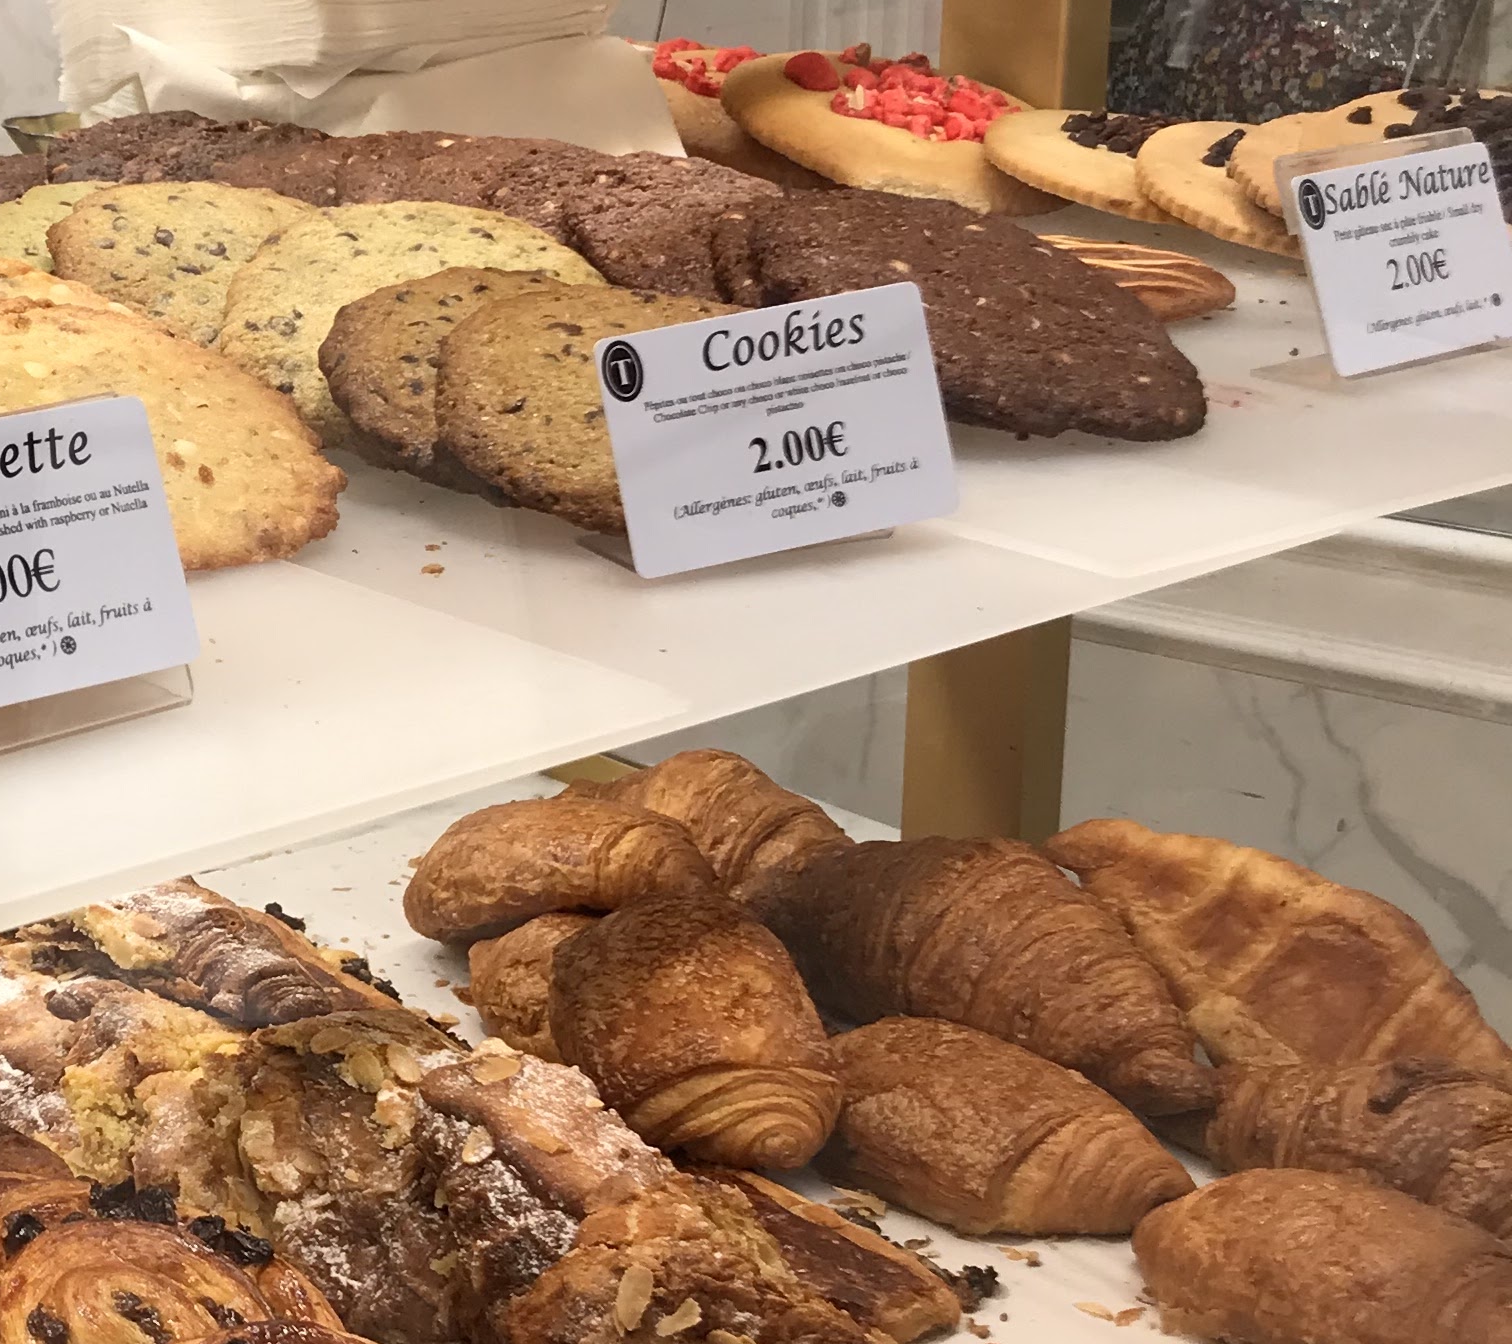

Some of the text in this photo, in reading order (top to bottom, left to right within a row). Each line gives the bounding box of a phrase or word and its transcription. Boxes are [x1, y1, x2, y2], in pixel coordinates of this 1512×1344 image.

[1325, 161, 1491, 217] Sablé Nature
[1386, 248, 1450, 291] 2.00€
[702, 310, 864, 372] Cookies
[749, 420, 848, 474] 2.00€
